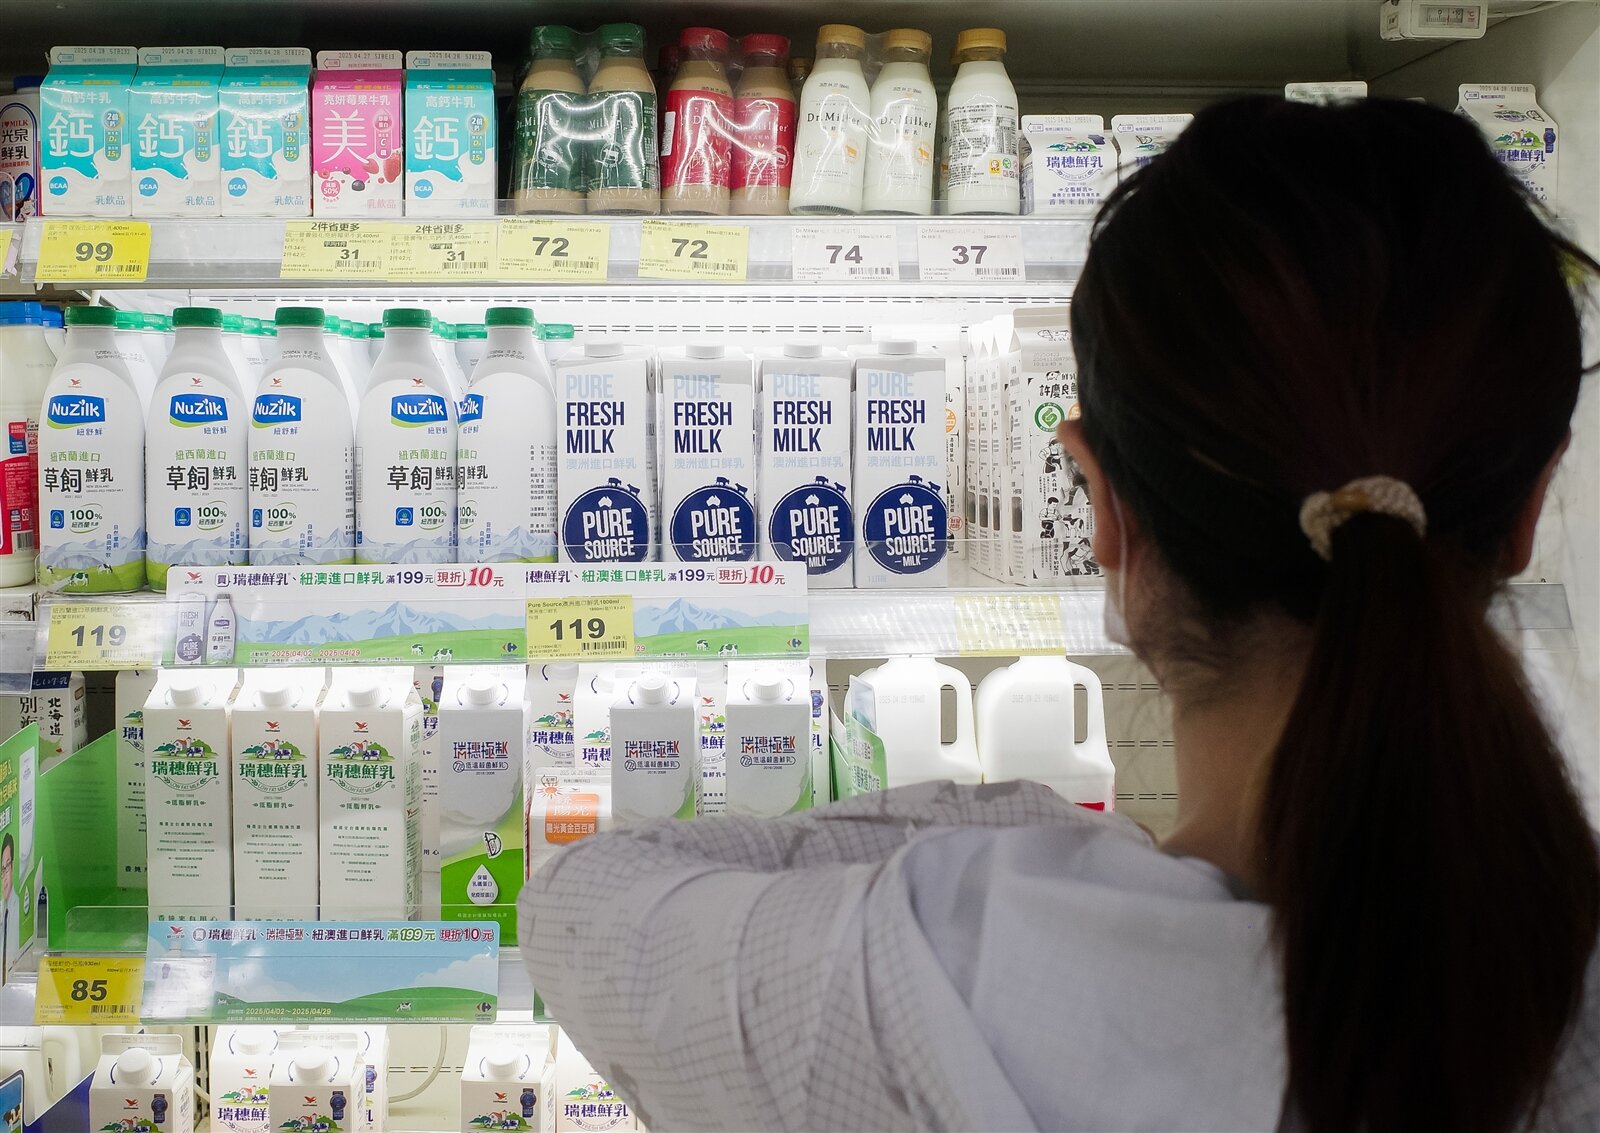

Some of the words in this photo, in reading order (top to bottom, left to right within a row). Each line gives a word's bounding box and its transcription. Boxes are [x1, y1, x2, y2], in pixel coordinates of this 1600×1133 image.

[61, 92, 111, 104] 高鈣牛乳
[150, 94, 201, 105] 高鈣牛乳
[238, 94, 289, 105] 高鈣牛乳
[324, 94, 391, 106] 亮妍莓果牛乳
[425, 95, 476, 108] 高鈣牛乳
[2, 128, 28, 144] 光泉
[49, 112, 94, 157] 鈣
[138, 113, 184, 158] 鈣
[226, 113, 272, 158] 鈣
[321, 109, 369, 164] 美
[413, 116, 459, 160] 鈣
[1, 146, 29, 160] 鮮乳
[1046, 155, 1104, 168] 瑞穗鮮乳
[1494, 149, 1546, 162] 瑞穗鮮乳
[95, 195, 126, 206] 乳飲品
[185, 195, 215, 206] 乳飲品
[274, 195, 304, 206] 乳飲品
[311, 222, 360, 232] 2件省更多
[416, 224, 464, 234] 2件省更多
[76, 242, 114, 262] 99
[340, 249, 359, 260] 31
[532, 236, 570, 257] 72
[672, 238, 709, 259] 72
[826, 245, 863, 264] 74
[952, 246, 988, 265] 37
[446, 250, 465, 262] 31
[565, 374, 614, 399] PURE
[673, 374, 721, 398] PURE
[773, 374, 821, 397] PURE
[867, 373, 914, 397] PURE
[52, 398, 100, 417] NuZilk
[174, 398, 222, 416] NuZilk
[255, 399, 296, 416] NuZilk
[398, 399, 444, 416] NuZilk
[566, 401, 625, 426] FRESH
[674, 402, 732, 426] FRESH
[773, 400, 832, 424] FRESH
[868, 400, 926, 424] FRESH
[566, 429, 615, 454] MILK
[674, 429, 722, 453] MILK
[773, 428, 822, 452] MILK
[868, 427, 915, 452] MILK
[51, 450, 102, 462] 紐西蘭進口
[176, 448, 226, 460] 紐西蘭進口
[398, 449, 448, 461] 紐西蘭進口
[773, 456, 844, 468] 澳洲進口鮮乳
[867, 456, 938, 468] 澳洲進口鮮乳
[566, 457, 637, 470] 澳洲進口鮮乳
[673, 457, 745, 470] 澳洲進口鮮乳
[166, 466, 237, 491] 草飼鮮乳
[70, 510, 103, 520] 100%
[196, 507, 228, 518] 100%
[267, 508, 296, 519] 100%
[420, 506, 447, 518] 100%
[789, 505, 838, 536] PURE
[884, 504, 933, 536] PURE
[582, 508, 634, 540] PURE
[690, 506, 742, 539] PURE
[585, 536, 636, 558] SOURCE
[692, 535, 742, 557] SOURCE
[791, 534, 841, 556] SOURCE
[885, 534, 935, 556] SOURCE
[808, 556, 828, 568] MILK
[902, 556, 921, 567] MILK
[217, 575, 227, 586] 買
[386, 571, 434, 584] 滿199元
[437, 572, 462, 584] 現折
[467, 567, 504, 586] 10元
[668, 569, 715, 582] 滿199元
[719, 569, 743, 582] 現折
[749, 565, 786, 585] 10元
[72, 625, 126, 647] 119
[550, 618, 606, 640] 119
[48, 697, 64, 736] 北海道
[152, 760, 219, 776] 瑞穗鮮乳
[239, 763, 308, 779] 瑞穗鮮乳
[327, 764, 396, 780] 瑞穗鮮乳
[388, 928, 436, 942] 滿199元
[71, 980, 108, 1002] 85
[217, 1107, 269, 1121] 瑞穗鮮
[564, 1103, 629, 1118] 瑞穗鮮乳
